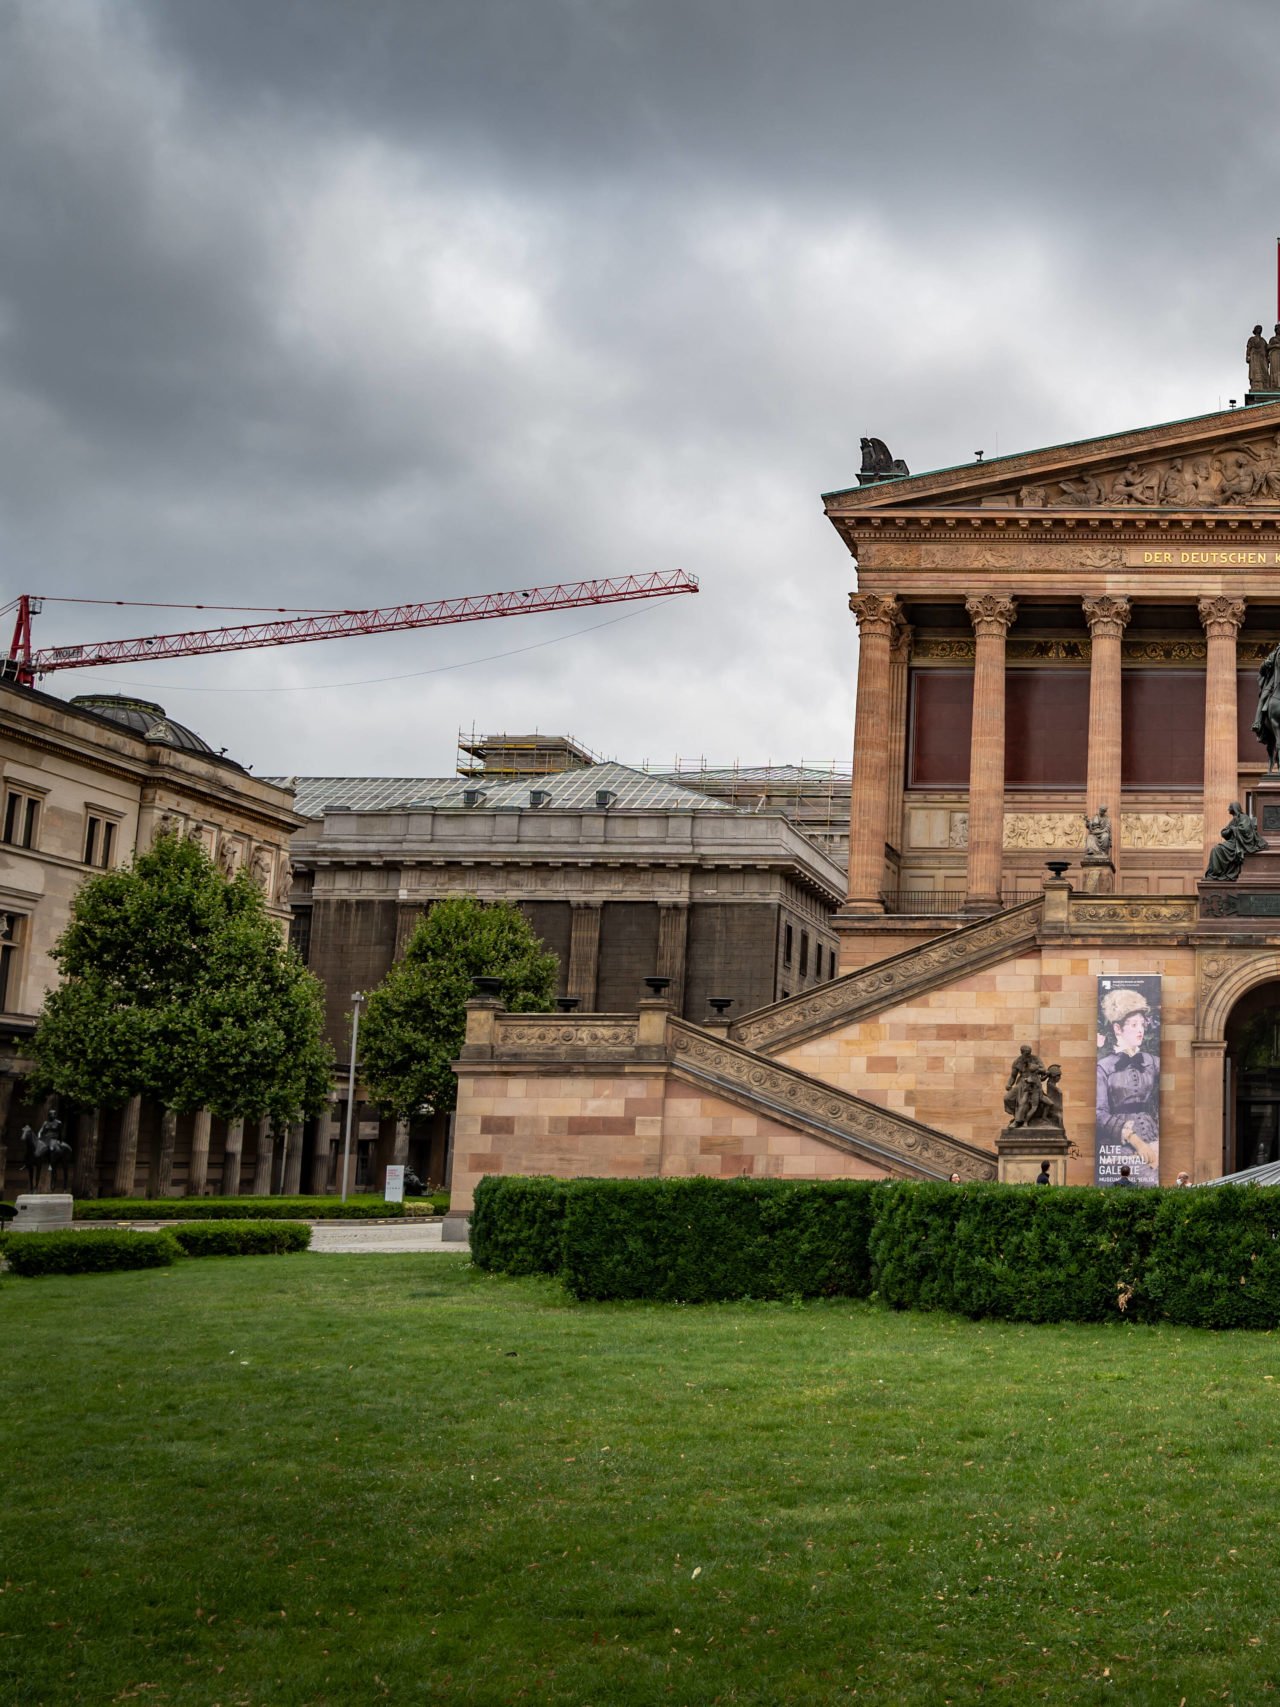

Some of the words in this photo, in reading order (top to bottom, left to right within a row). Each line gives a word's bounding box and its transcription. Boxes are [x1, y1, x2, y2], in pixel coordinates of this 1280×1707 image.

[1144, 552, 1172, 563] DER
[1181, 552, 1267, 563] DEUTSCHEN
[1099, 1144, 1121, 1154] ALTE
[1099, 1155, 1147, 1165] NATIONAL
[1098, 1165, 1140, 1175] GALEIE
